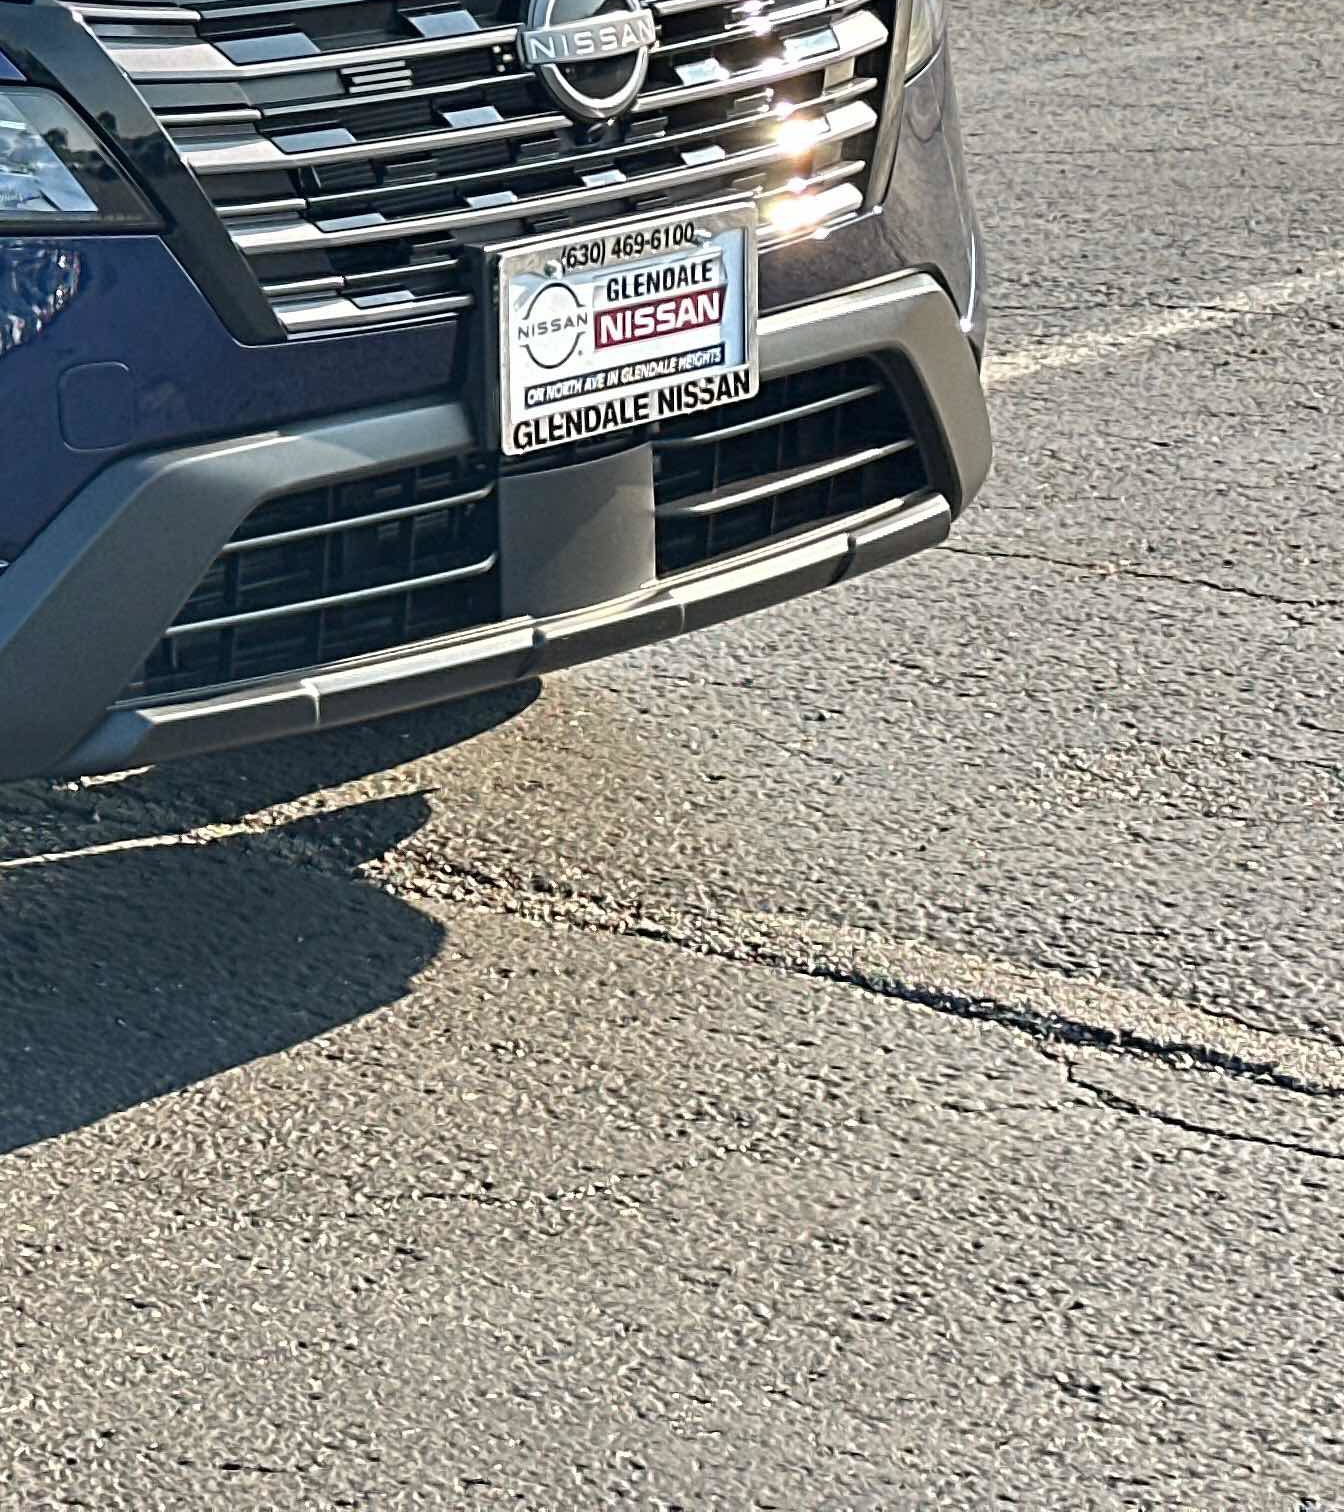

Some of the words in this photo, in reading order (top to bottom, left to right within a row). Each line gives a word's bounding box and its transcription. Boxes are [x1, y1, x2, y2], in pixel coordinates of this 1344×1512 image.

[529, 20, 654, 60] NISSAN
[561, 239, 606, 275] (630)
[611, 221, 695, 259] 469-6100
[606, 259, 713, 302] GLENDALE
[518, 312, 588, 341] NISSAN
[600, 291, 721, 344] NISSAN
[584, 372, 606, 392] AVE
[607, 368, 620, 387] IN
[620, 356, 678, 384] GLENDALE
[513, 392, 650, 450] GLENDALE
[658, 369, 751, 416] NISSAN
